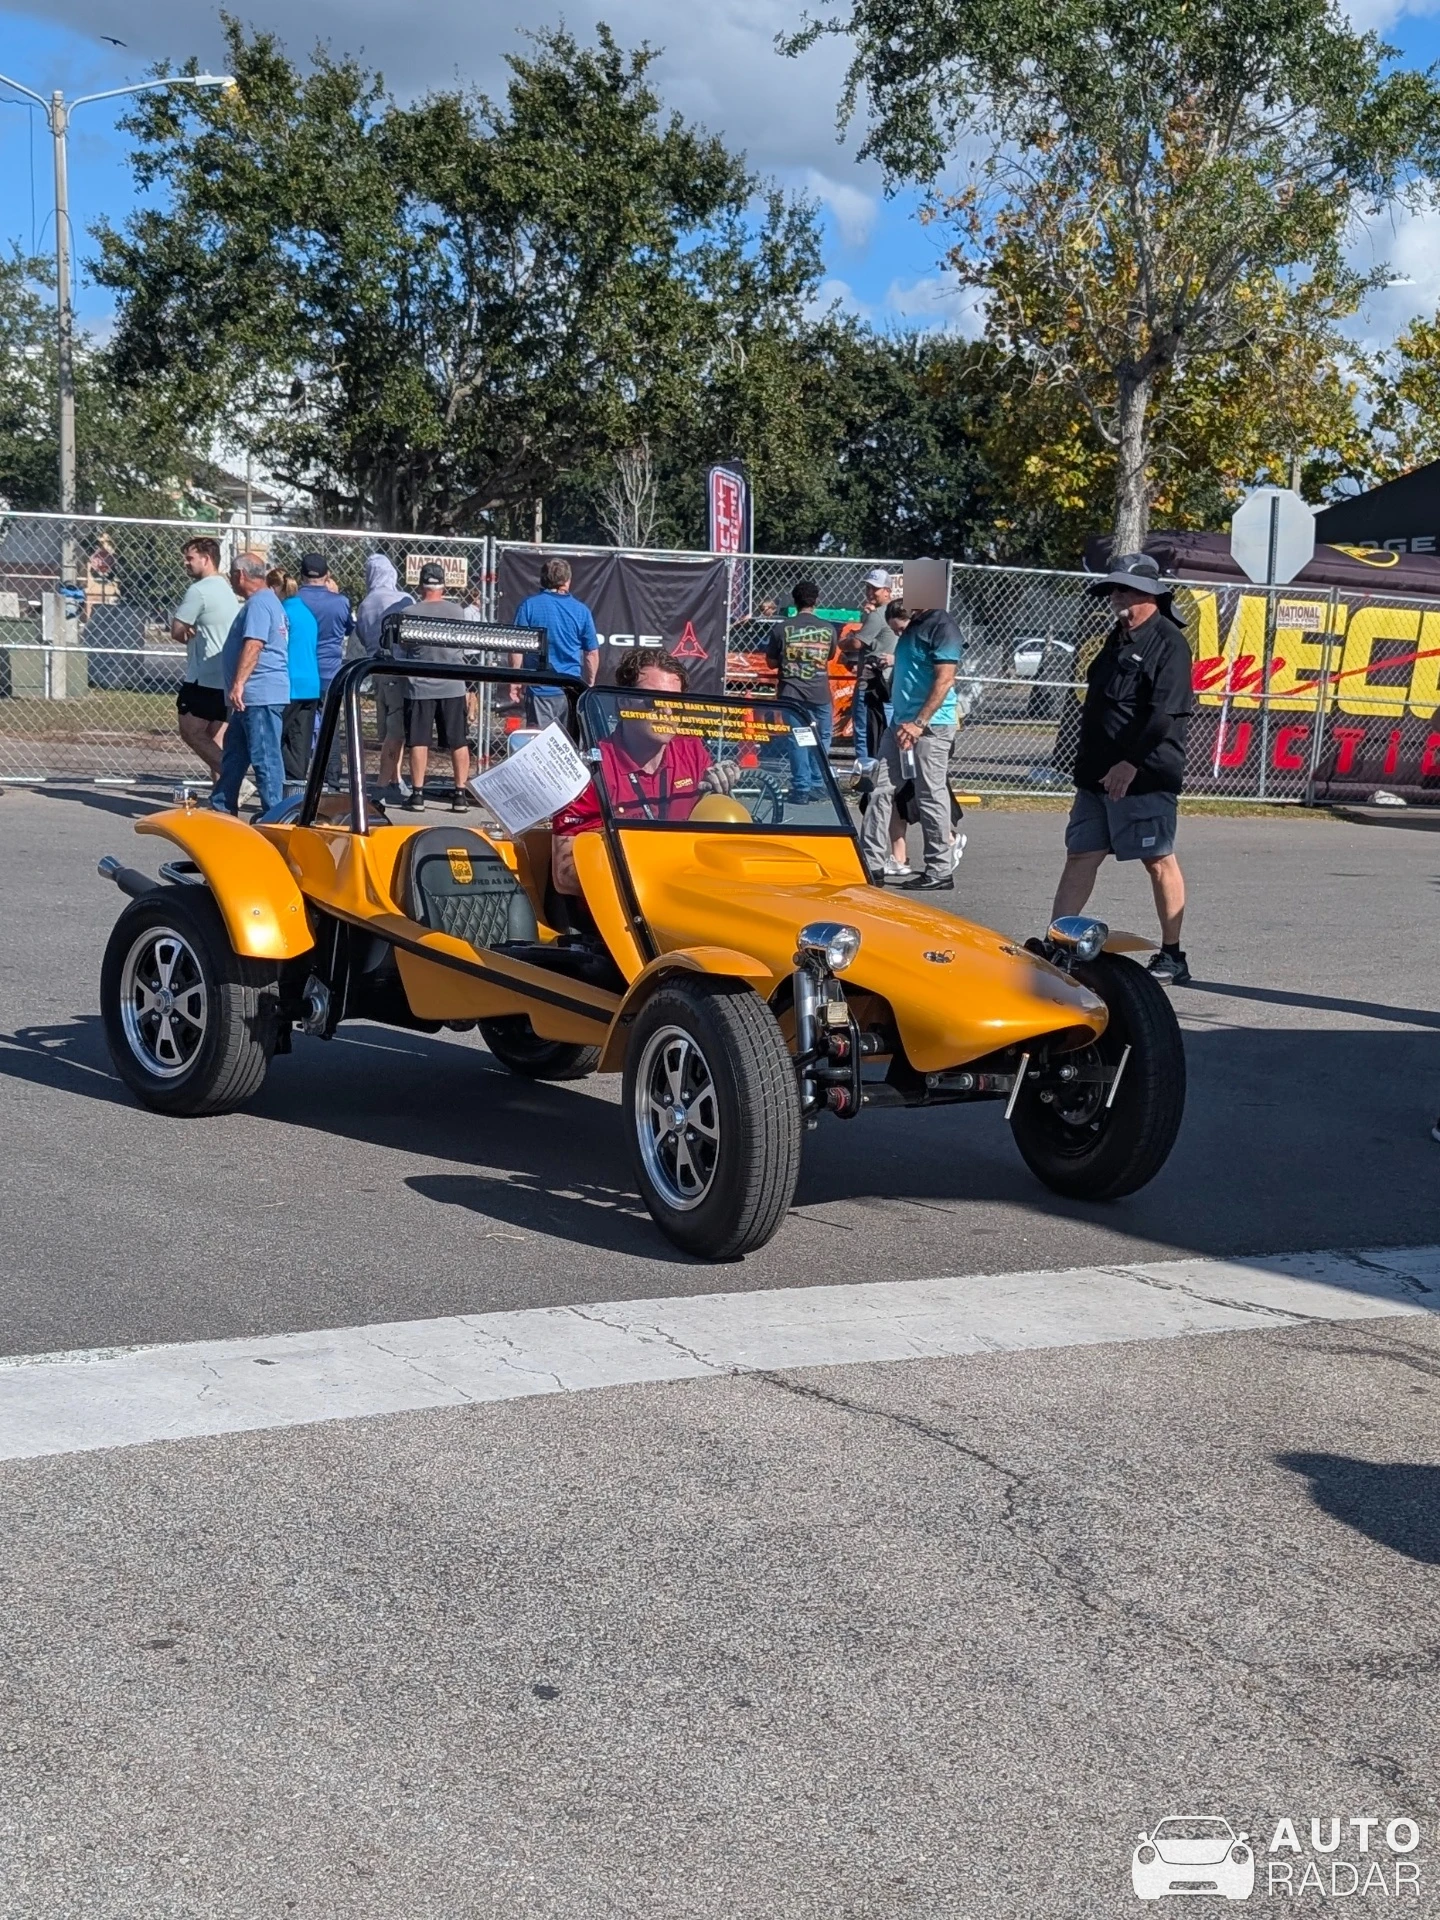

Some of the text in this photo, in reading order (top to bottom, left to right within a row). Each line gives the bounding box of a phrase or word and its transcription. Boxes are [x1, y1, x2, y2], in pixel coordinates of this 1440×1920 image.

[1278, 605, 1320, 619] NATIONAL
[654, 699, 683, 709] MEYERS
[684, 702, 705, 711] MANX
[728, 706, 753, 715] BUGGY
[620, 710, 658, 720] CERTIFIED
[659, 714, 669, 722] AS
[682, 716, 721, 726] AUTHENTIC
[747, 721, 767, 730] MANX
[767, 723, 791, 732] BUGGY
[652, 725, 676, 735] TOTAL
[725, 731, 744, 740] DONE
[548, 736, 565, 755] START
[563, 755, 582, 780] VEHICLE
